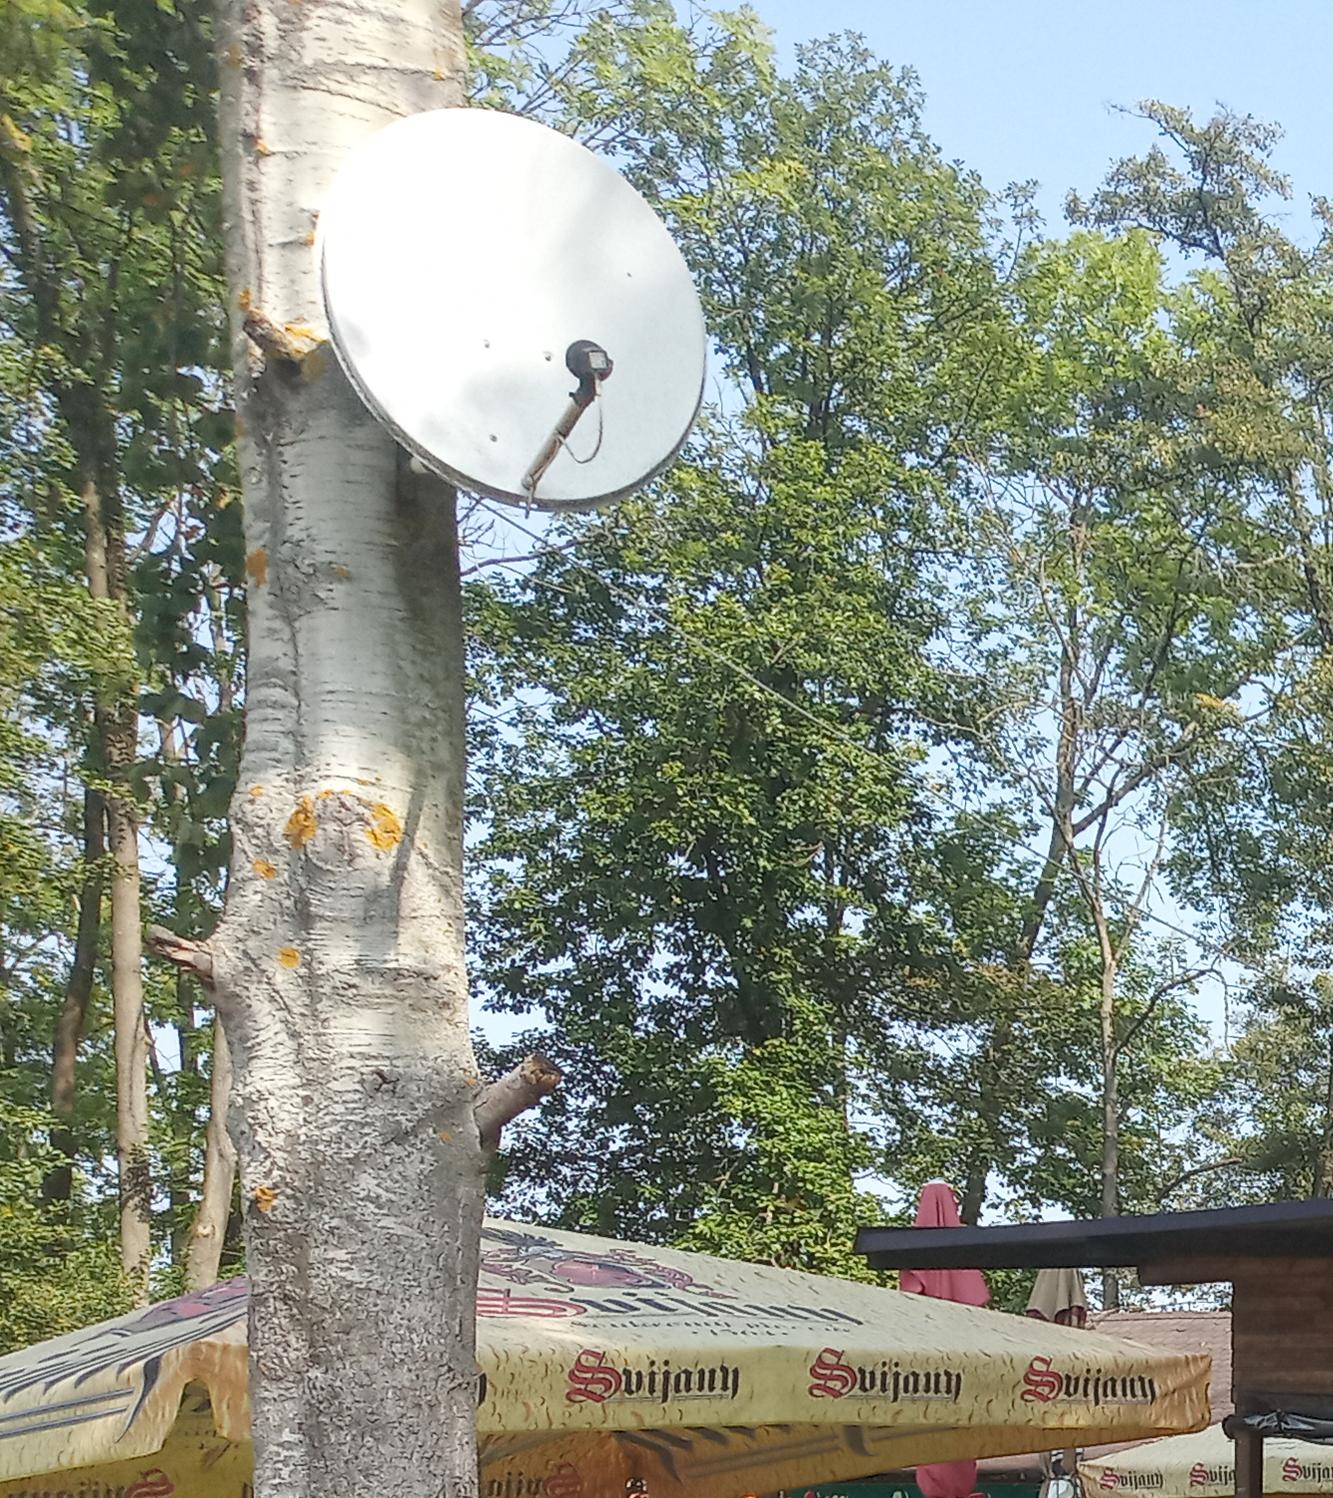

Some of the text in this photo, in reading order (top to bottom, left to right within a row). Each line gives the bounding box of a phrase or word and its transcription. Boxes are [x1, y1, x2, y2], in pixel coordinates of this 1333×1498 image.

[565, 1349, 739, 1404] Svijany
[808, 1347, 962, 1403] Svijany
[1020, 1355, 1157, 1406] Svijany
